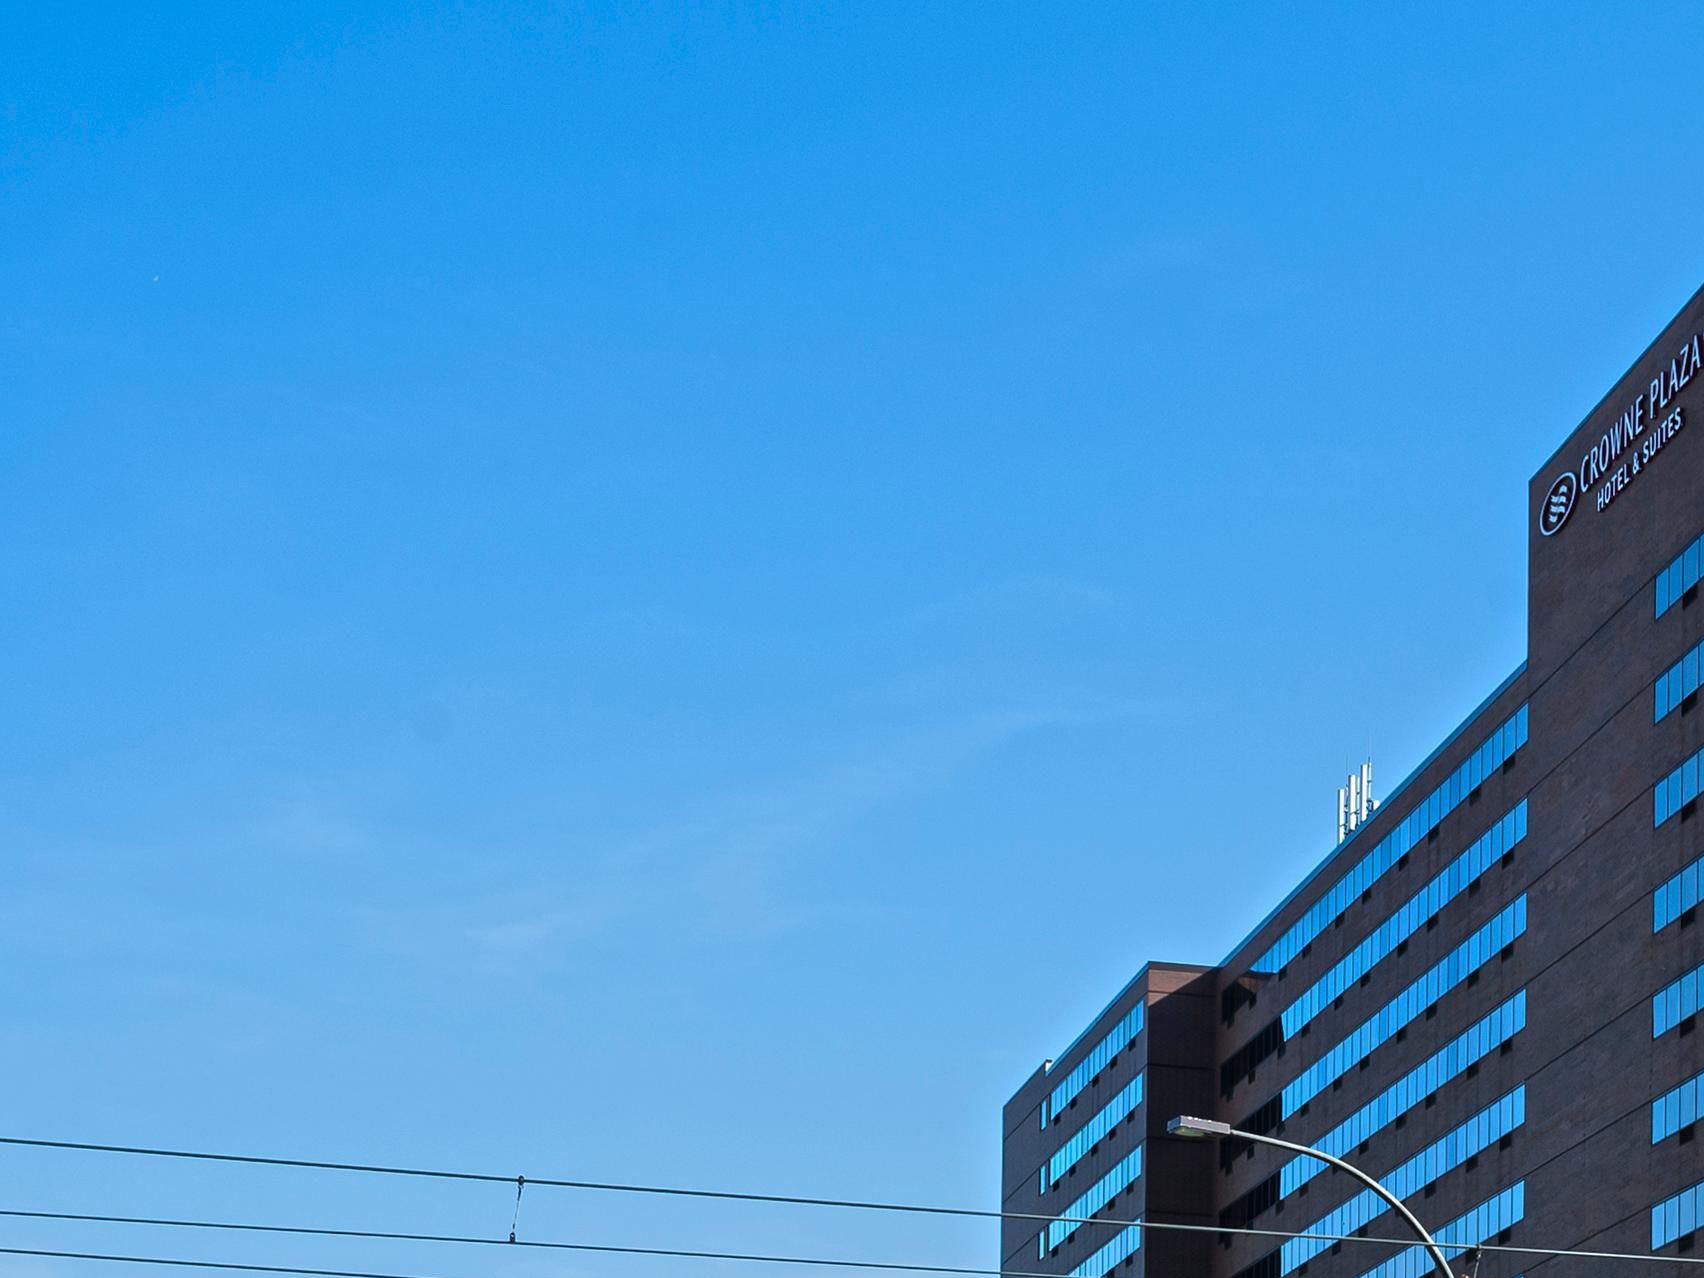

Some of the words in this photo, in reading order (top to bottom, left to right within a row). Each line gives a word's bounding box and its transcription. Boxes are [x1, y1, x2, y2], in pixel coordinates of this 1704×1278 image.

[1580, 394, 1644, 492] CROWNE
[1597, 463, 1630, 512] HOTEL
[1632, 452, 1641, 474] &
[1643, 406, 1682, 464] SUITES
